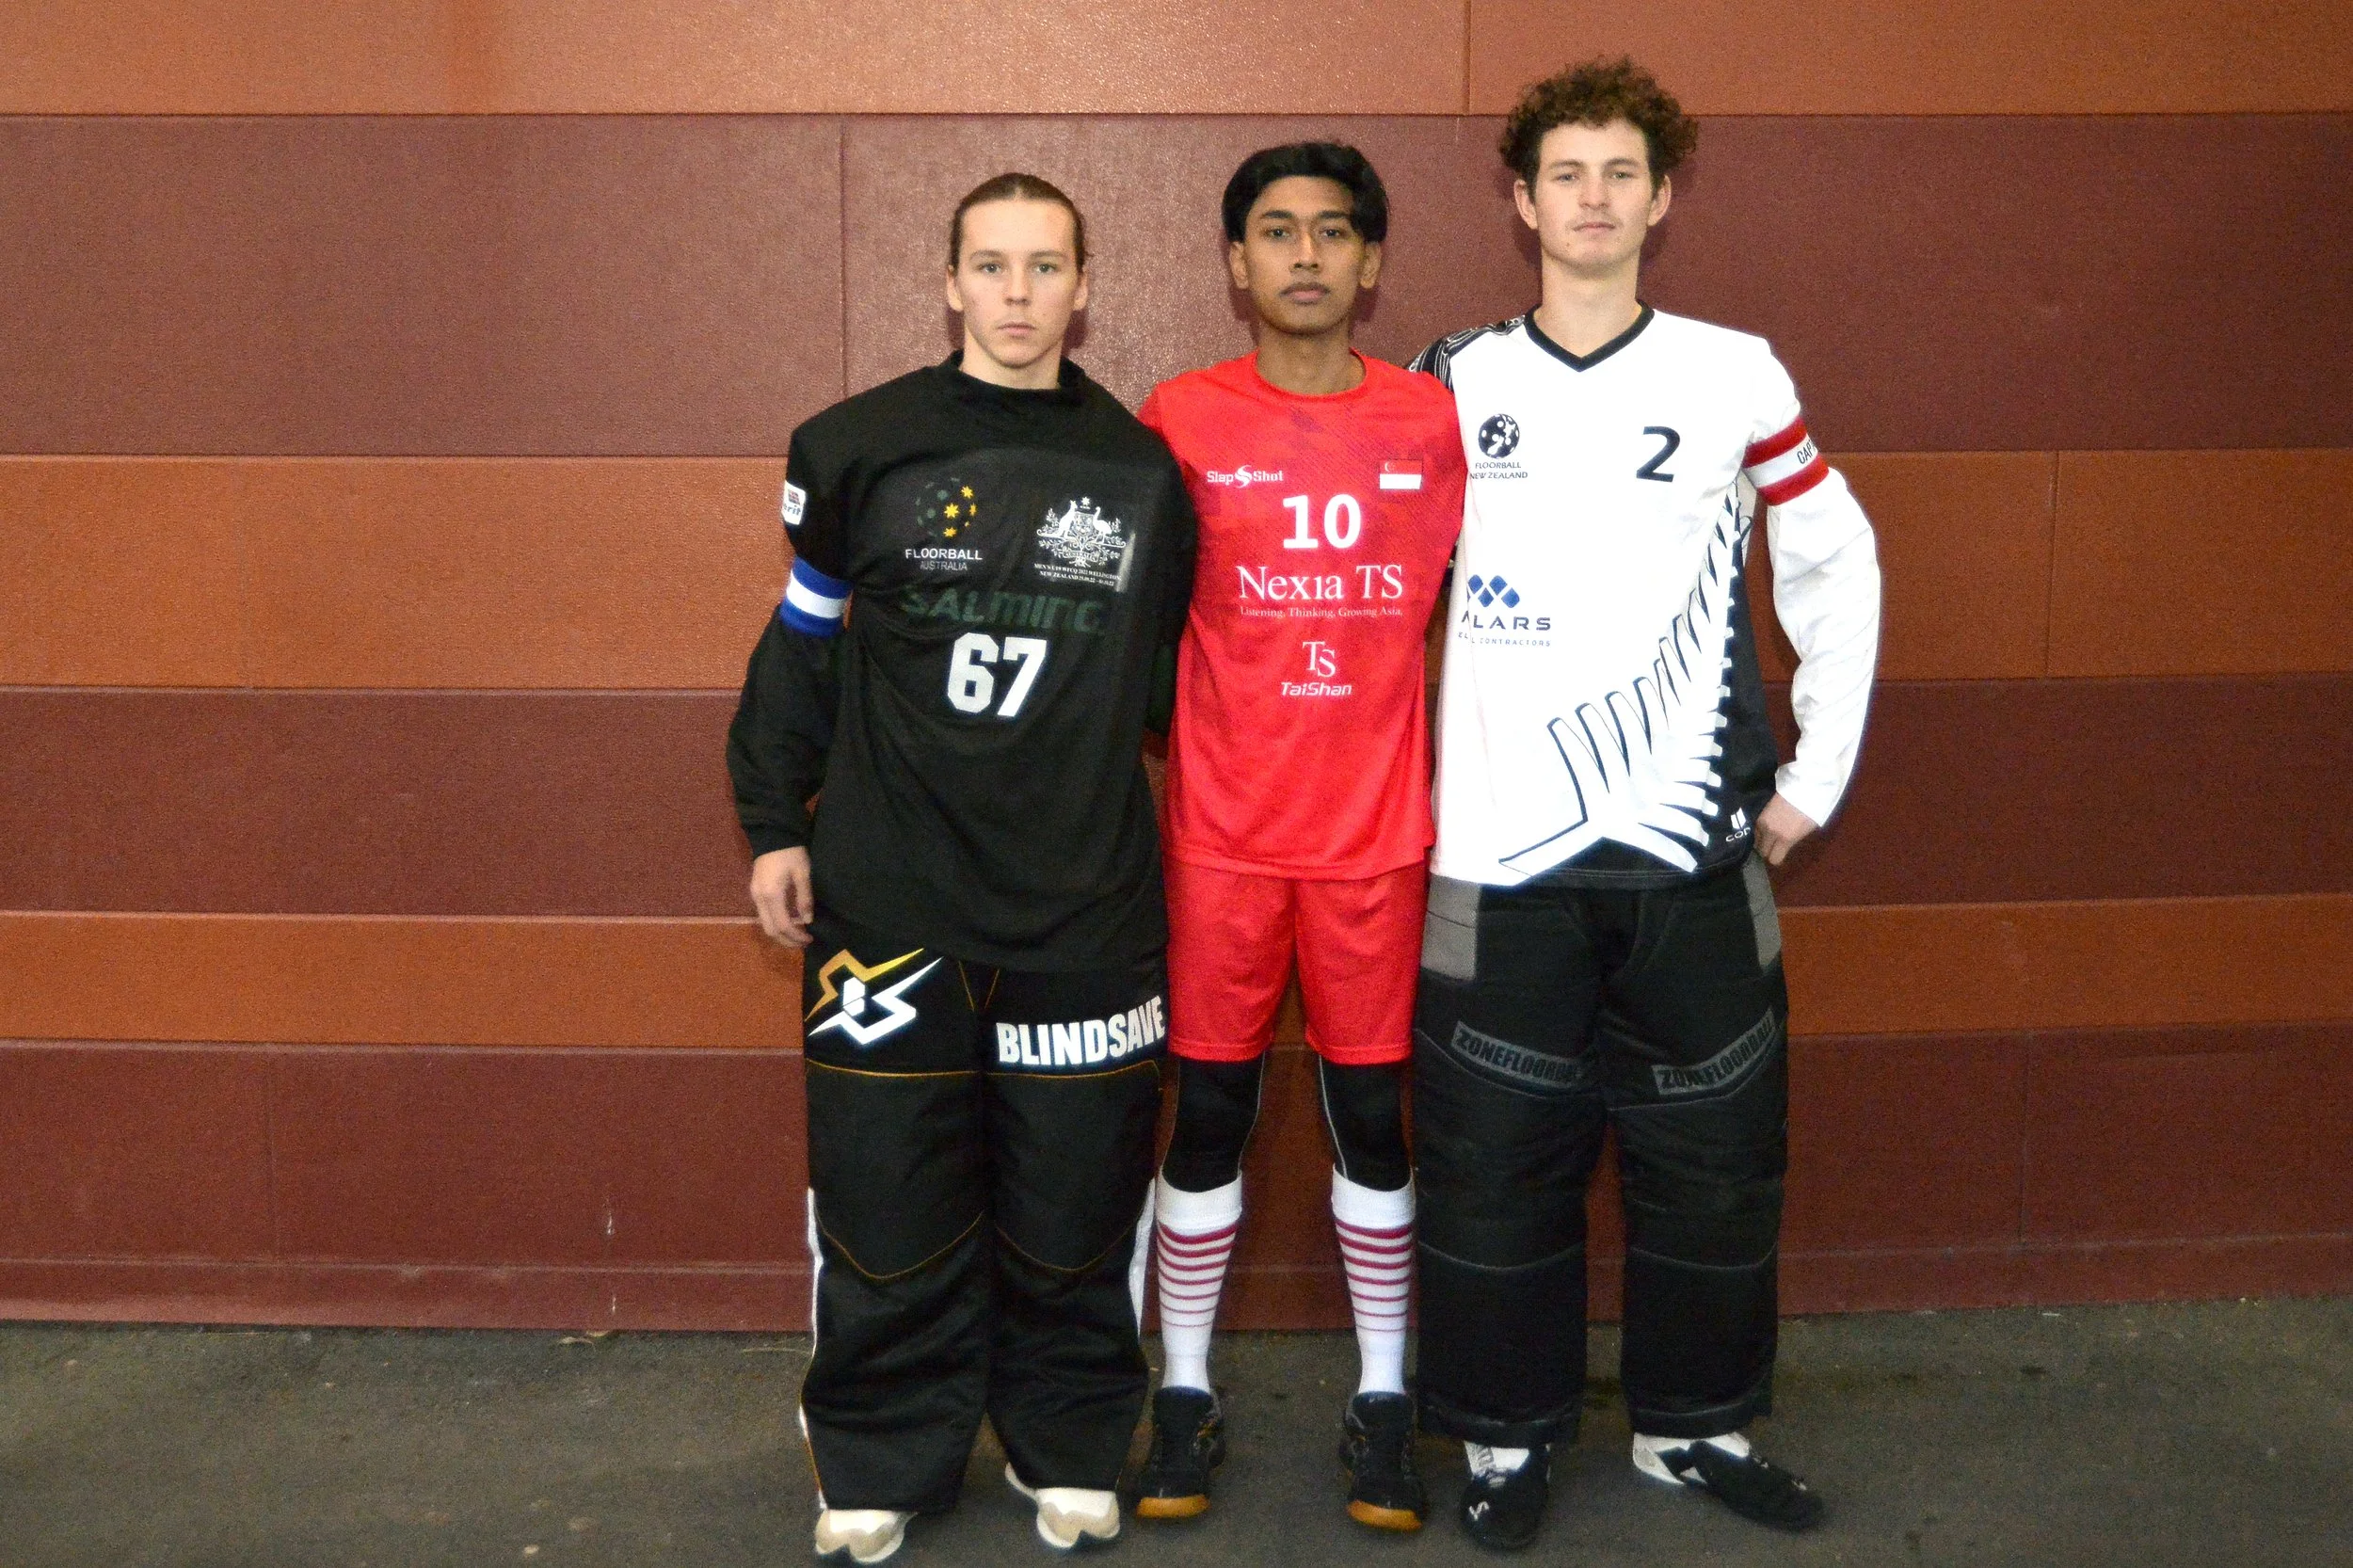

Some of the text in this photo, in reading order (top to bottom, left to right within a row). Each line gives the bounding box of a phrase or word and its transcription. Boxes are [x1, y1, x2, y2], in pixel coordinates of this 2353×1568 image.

[1636, 425, 1681, 483] 2
[1475, 461, 1522, 470] FLOORBALL
[1207, 471, 1285, 486] Slap Shot
[1469, 472, 1487, 480] NEW
[1282, 494, 1362, 549] 10
[904, 548, 984, 561] FLOORBALL
[920, 560, 968, 571] AUSTRALIA
[1236, 565, 1403, 600] Nexia TS
[1288, 607, 1336, 618] Thinking,
[1337, 606, 1377, 616] Growing
[1302, 641, 1337, 678] TS
[947, 632, 1047, 717] 67
[1281, 681, 1353, 697] TaiShan
[996, 996, 1166, 1066] BLINDSAVE
